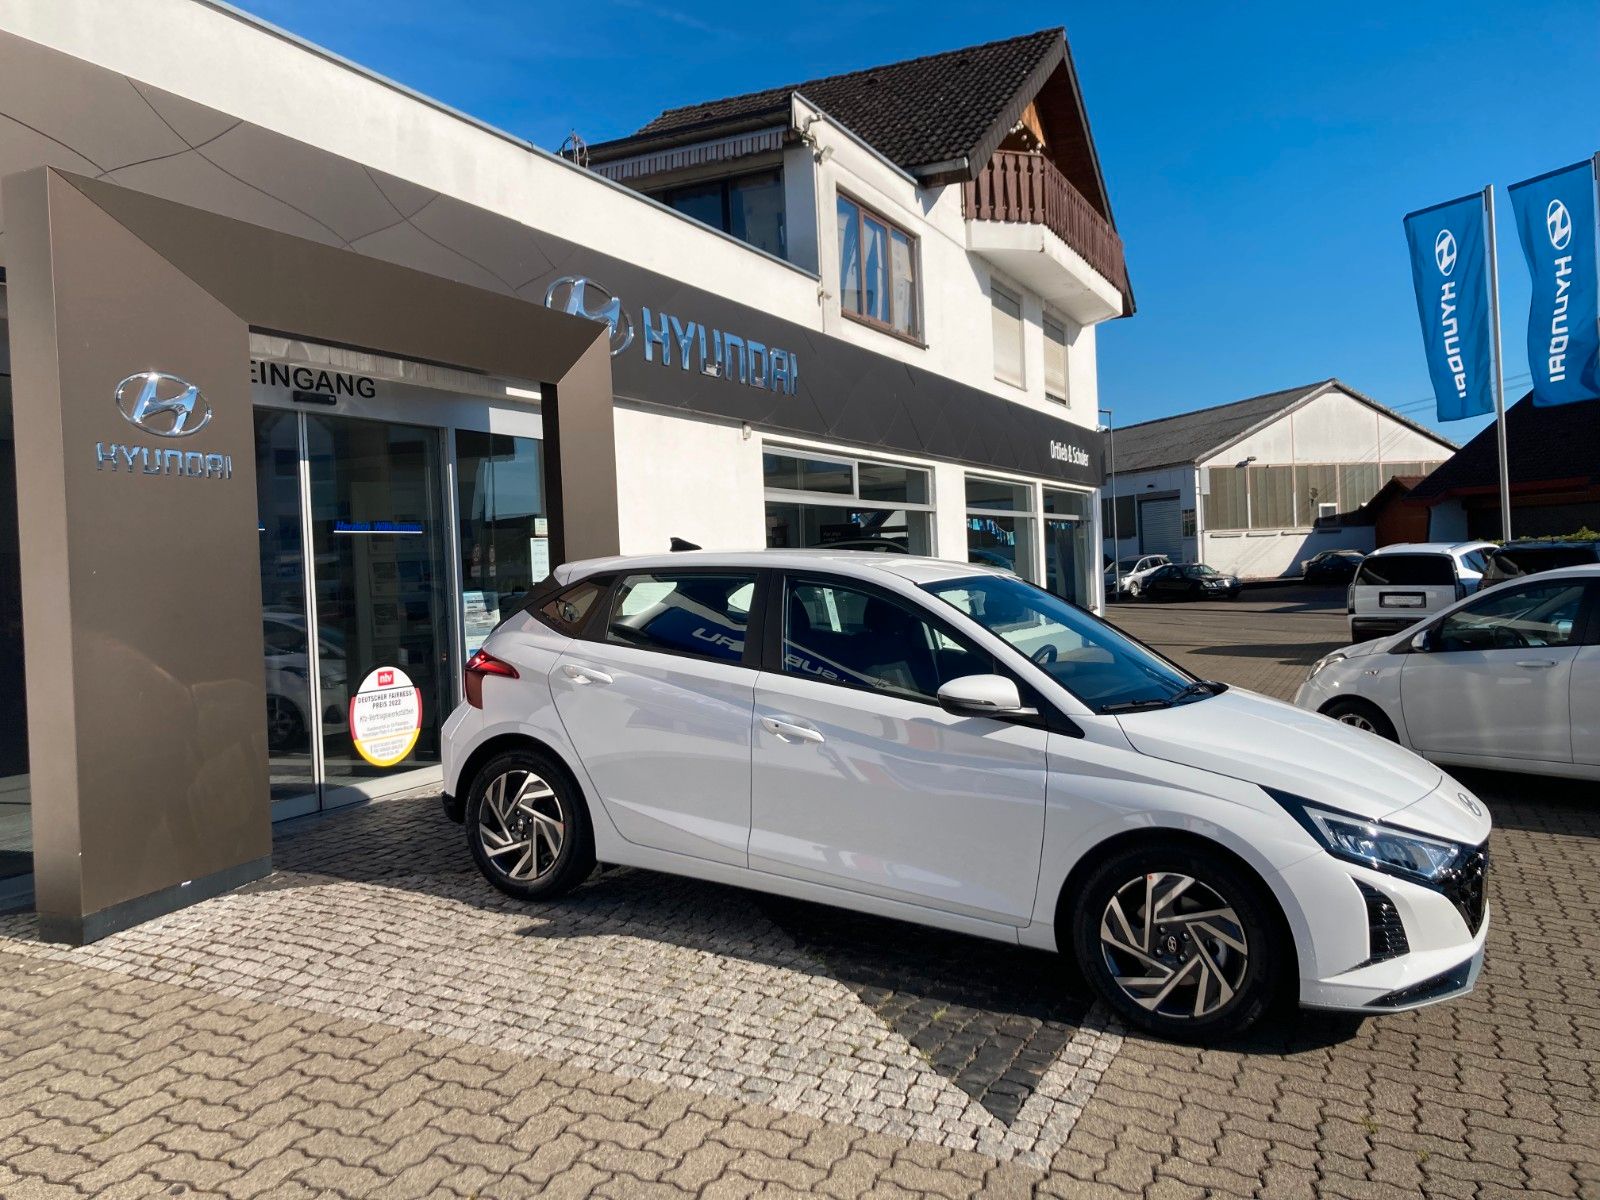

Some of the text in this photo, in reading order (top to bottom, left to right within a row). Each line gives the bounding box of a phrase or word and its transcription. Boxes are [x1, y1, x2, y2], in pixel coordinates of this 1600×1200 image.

[642, 305, 799, 397] HYUNDAI
[95, 440, 233, 480] HYUNDAI
[358, 692, 387, 704] DEUTSCHER
[372, 701, 388, 709] PREIS
